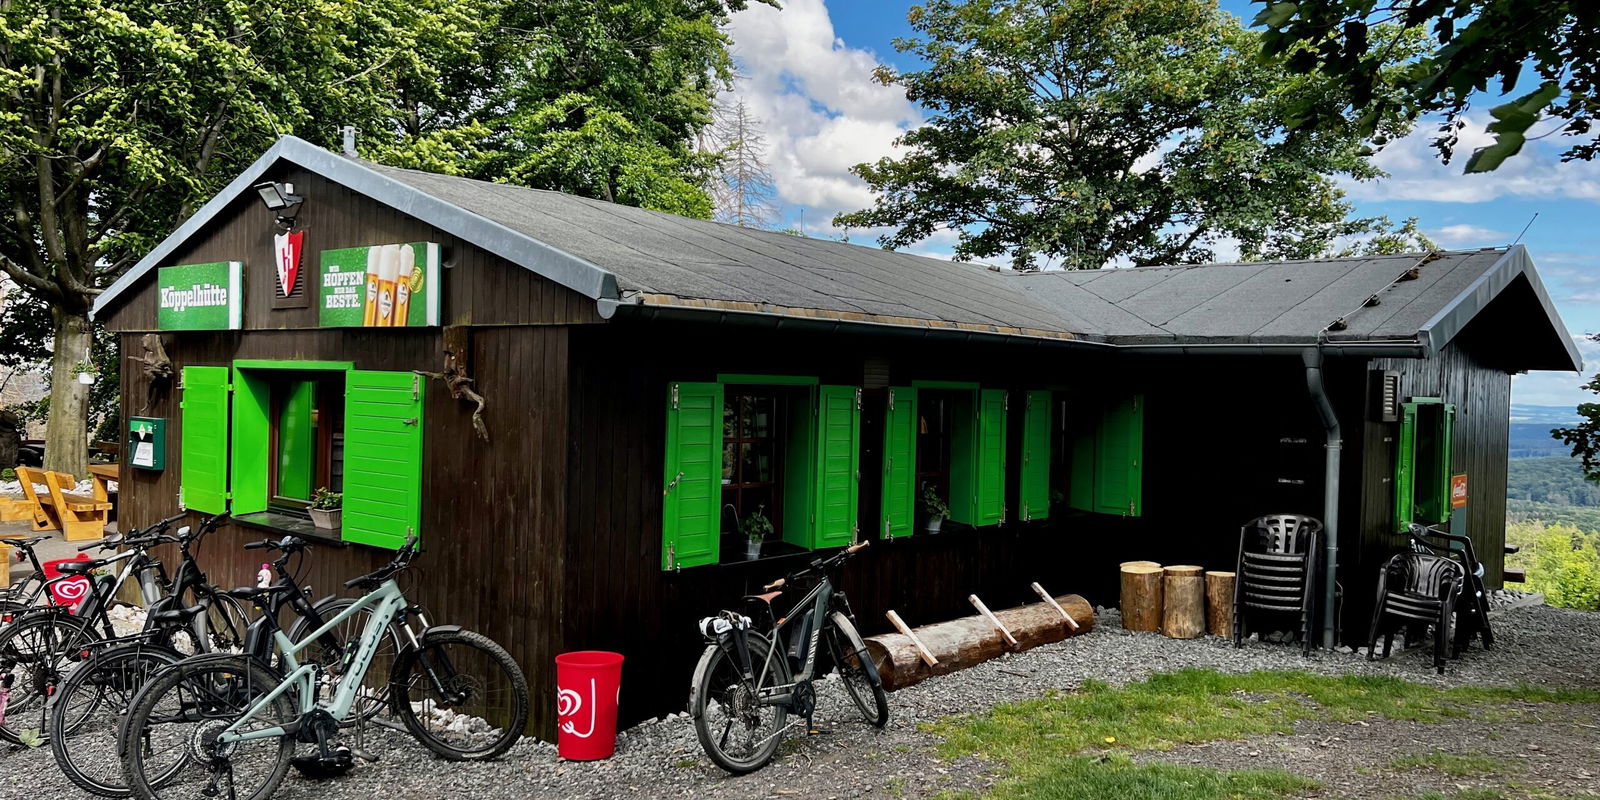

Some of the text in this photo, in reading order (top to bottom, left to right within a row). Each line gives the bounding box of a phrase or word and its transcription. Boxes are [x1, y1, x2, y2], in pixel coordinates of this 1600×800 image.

[323, 271, 365, 287] HOPFEN
[161, 283, 226, 311] Köppelhütte
[325, 293, 361, 308] BESTE.
[807, 629, 820, 664] CANYON
